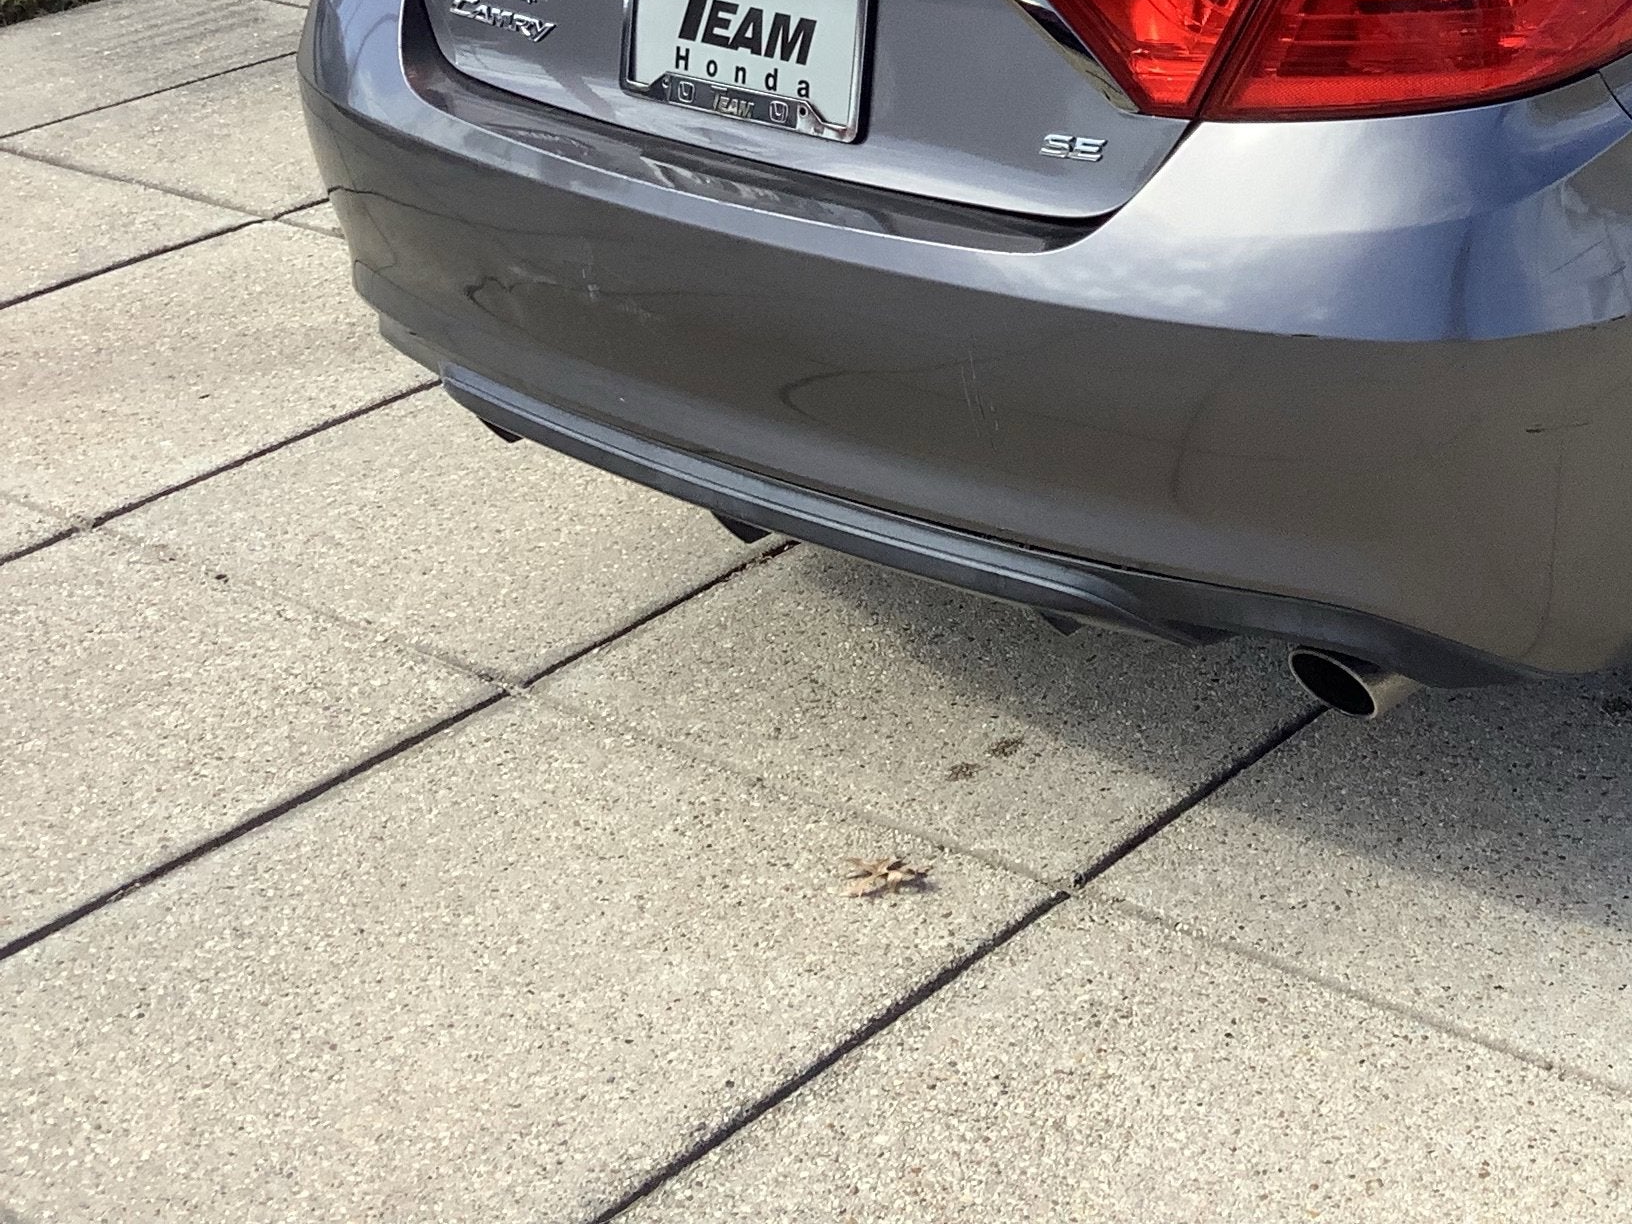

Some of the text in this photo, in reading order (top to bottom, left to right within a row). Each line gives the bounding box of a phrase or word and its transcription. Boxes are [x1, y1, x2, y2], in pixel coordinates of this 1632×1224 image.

[675, 46, 811, 99] Honda
[710, 85, 755, 119] TEAM
[1039, 133, 1108, 162] SE
